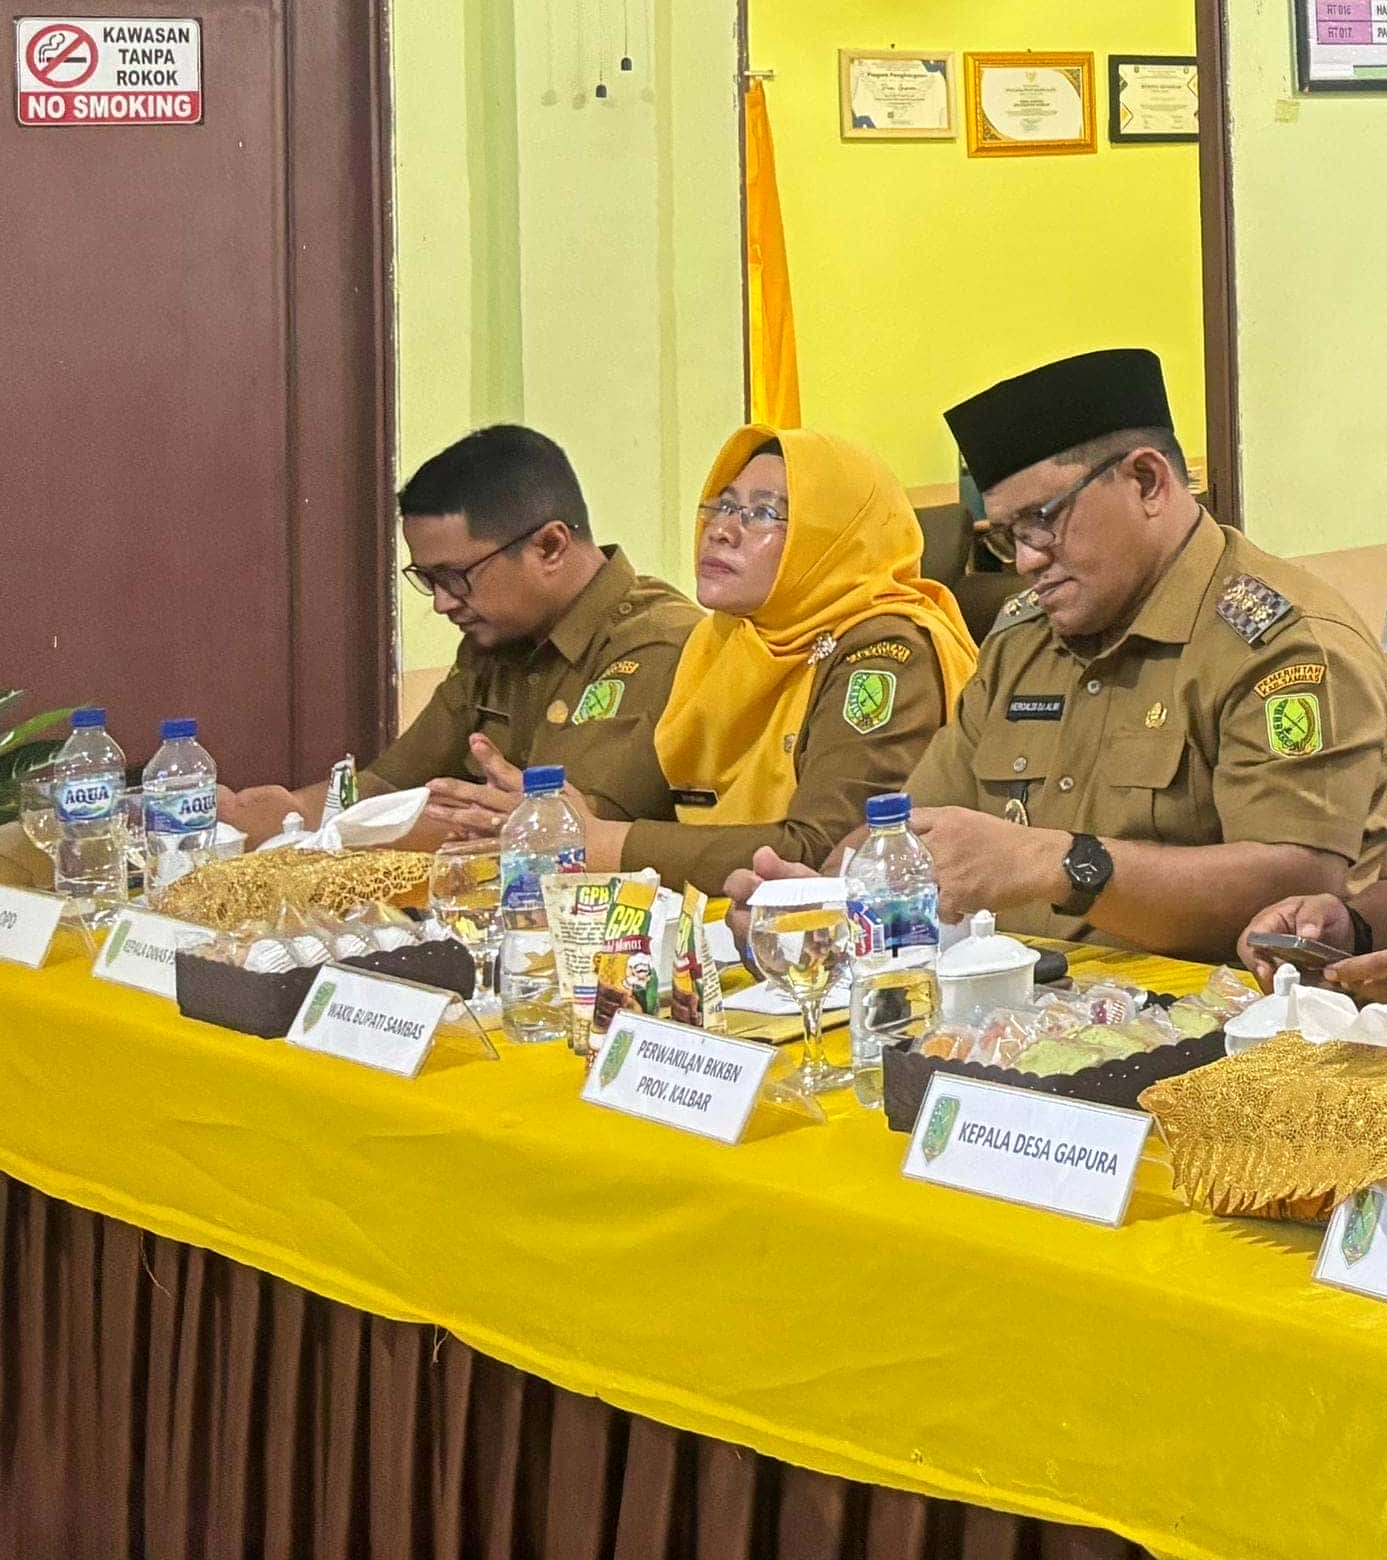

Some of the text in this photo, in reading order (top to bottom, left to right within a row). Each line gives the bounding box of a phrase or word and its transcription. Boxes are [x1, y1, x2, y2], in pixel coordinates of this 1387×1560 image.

[103, 27, 190, 43] KAWASAN
[119, 49, 175, 65] TANPA
[117, 70, 178, 86] ROKOK
[28, 95, 191, 119] NO SMOKING
[65, 786, 109, 804] AQUA
[605, 905, 645, 940] GPR
[327, 1002, 424, 1040] WAKIL BUPATI SAMBAS
[637, 1040, 743, 1083] PERWAKILAN BKKBN
[636, 1076, 712, 1112] PROV. KALBAR
[958, 1121, 1118, 1175] KEPALA DESA GAPURA
